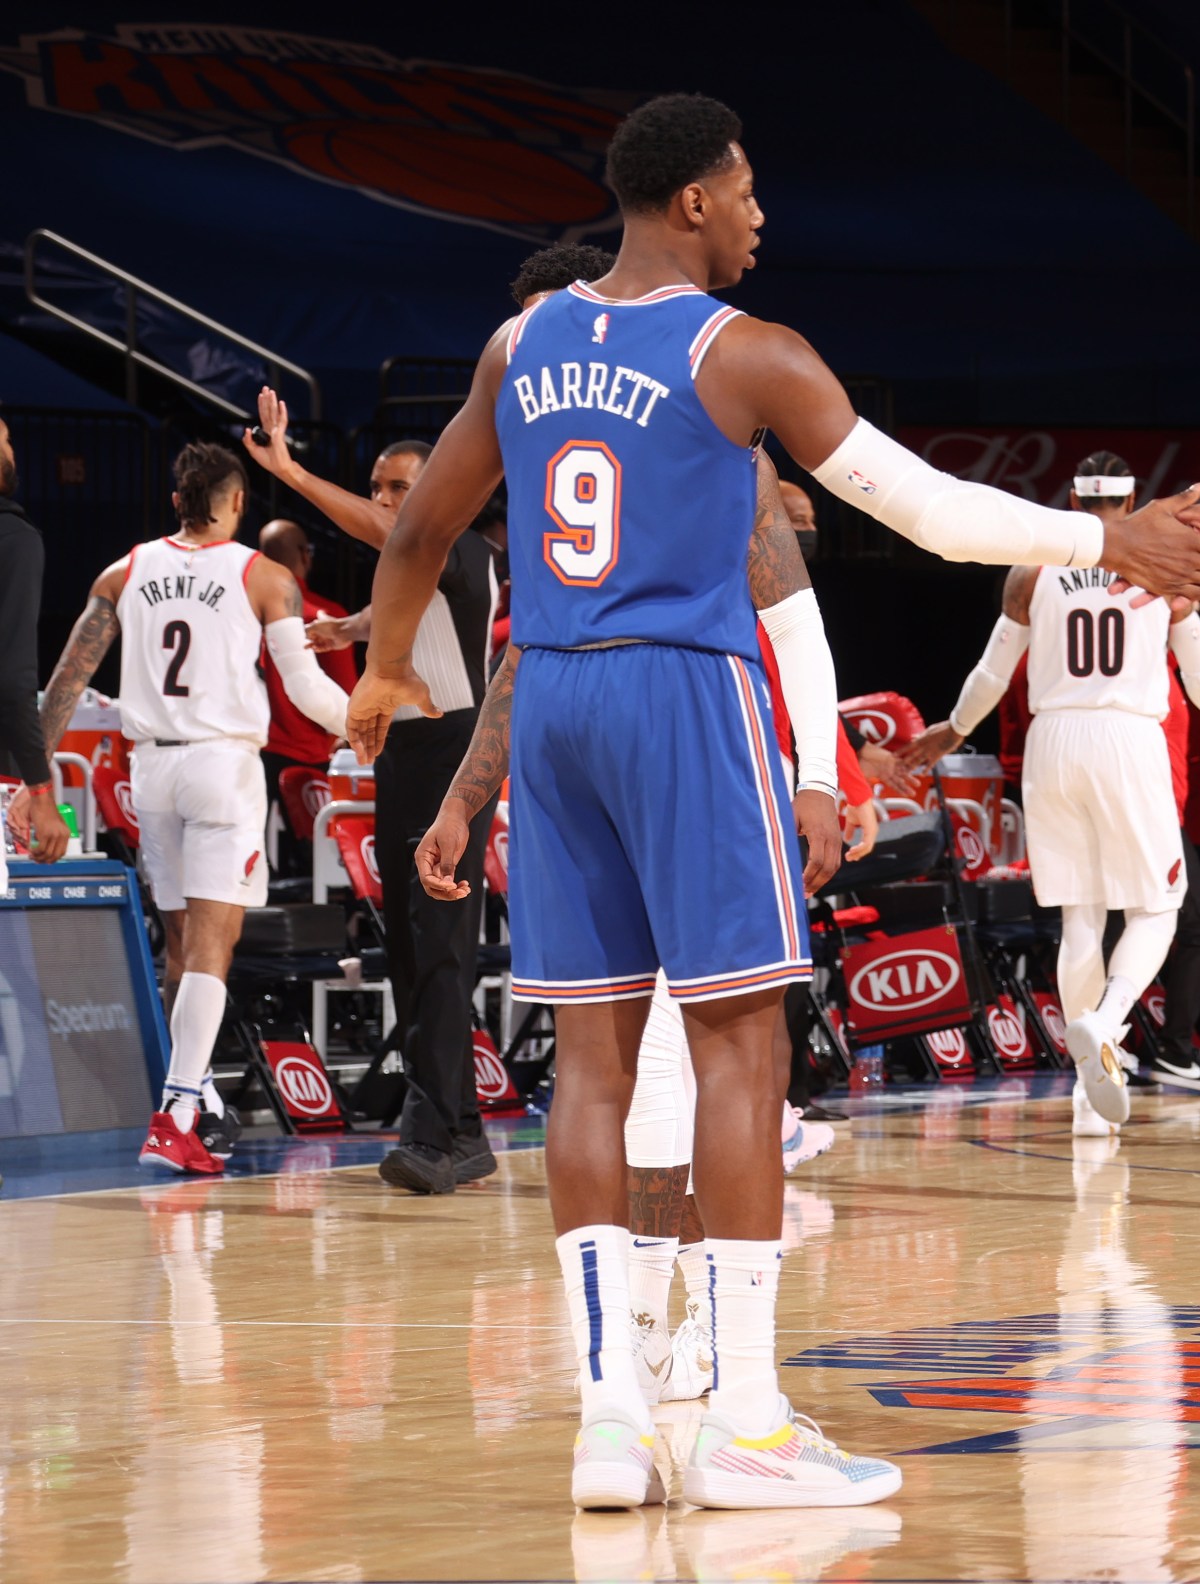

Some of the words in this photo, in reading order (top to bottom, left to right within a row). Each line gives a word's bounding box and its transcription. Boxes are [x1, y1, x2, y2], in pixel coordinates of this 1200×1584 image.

[513, 361, 670, 428] BARRETT
[543, 439, 622, 587] 9
[139, 575, 196, 607] TRENT
[198, 580, 226, 612] JR.
[162, 619, 191, 698] 2
[1067, 608, 1125, 678] 00
[28, 887, 52, 899] CHASE
[63, 886, 87, 898] CHASE
[98, 885, 123, 897] CHASE
[867, 959, 944, 1003] KIA
[47, 999, 130, 1041] Spectrum
[282, 1069, 326, 1102] KIA
